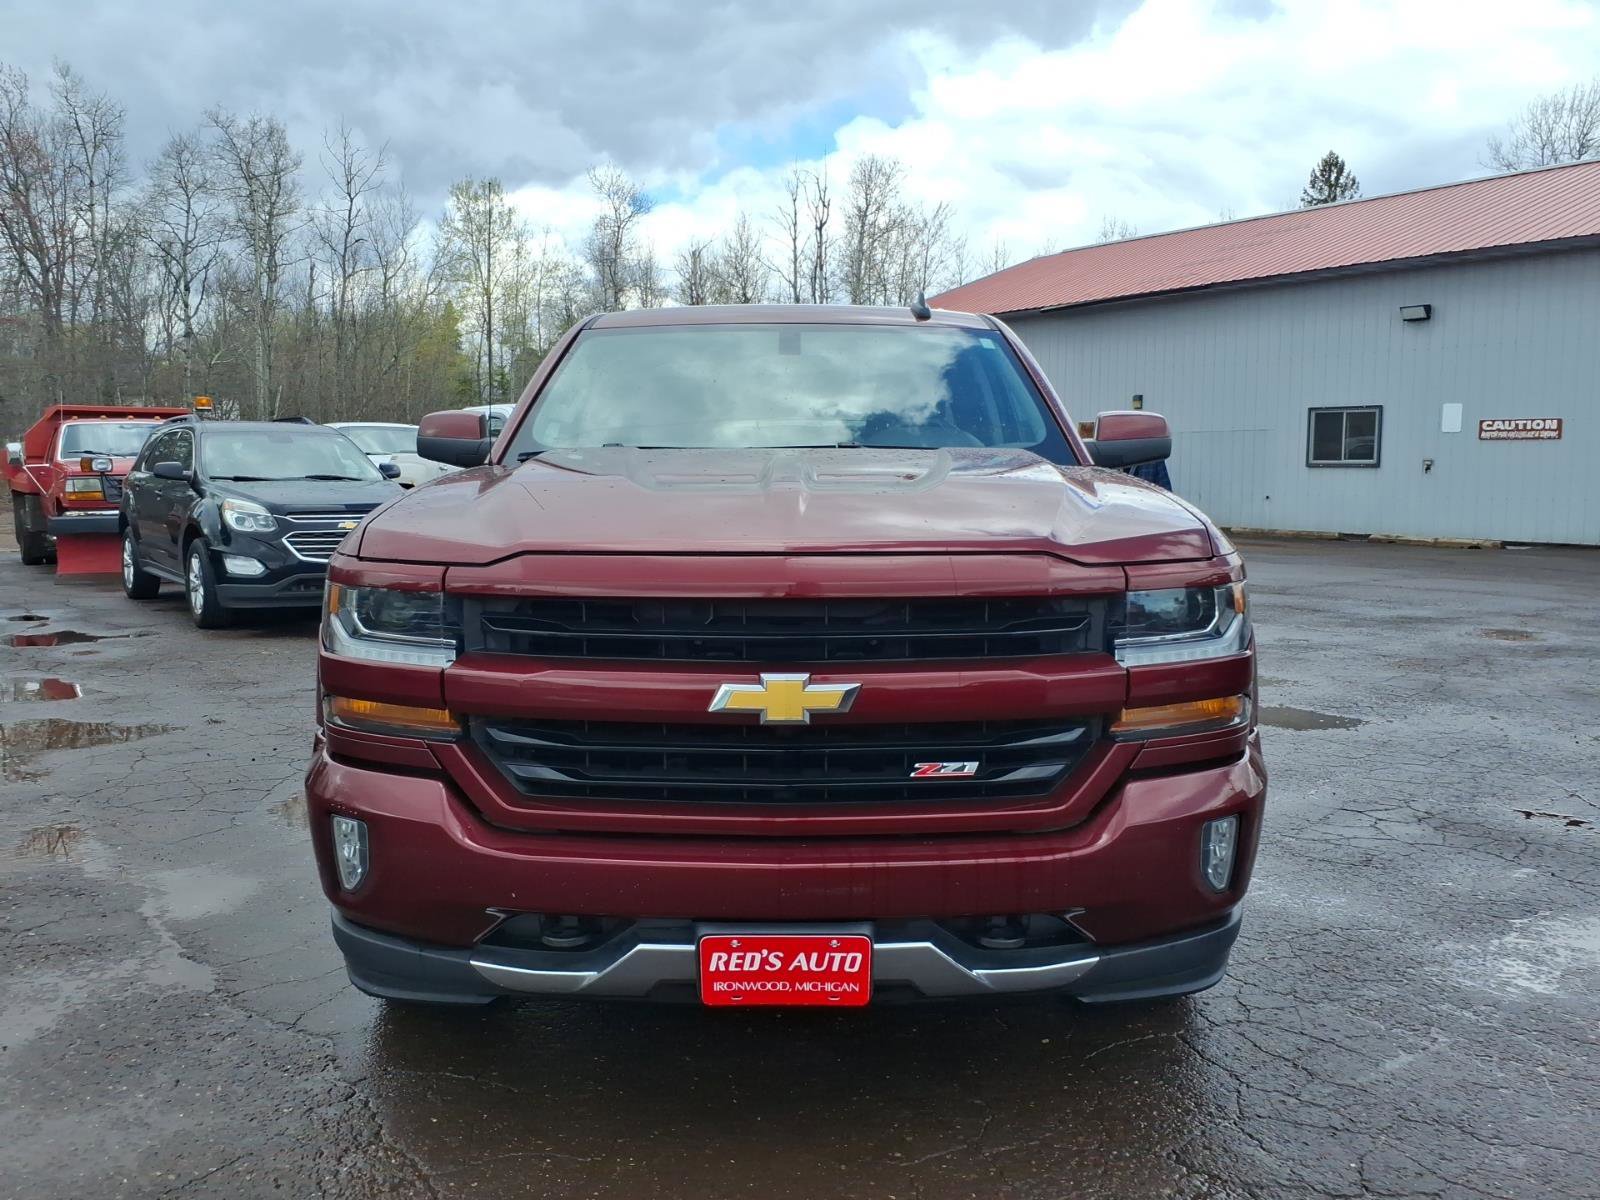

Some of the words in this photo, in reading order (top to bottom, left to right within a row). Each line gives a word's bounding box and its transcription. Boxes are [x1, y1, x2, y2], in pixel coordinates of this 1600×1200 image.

[1481, 419, 1558, 430] CAUTION
[910, 761, 979, 777] Z71
[709, 949, 784, 972] RED'S
[788, 952, 863, 973] AUTO
[713, 981, 792, 993] IRONWOOD,
[795, 981, 860, 993] MICHIGAN
